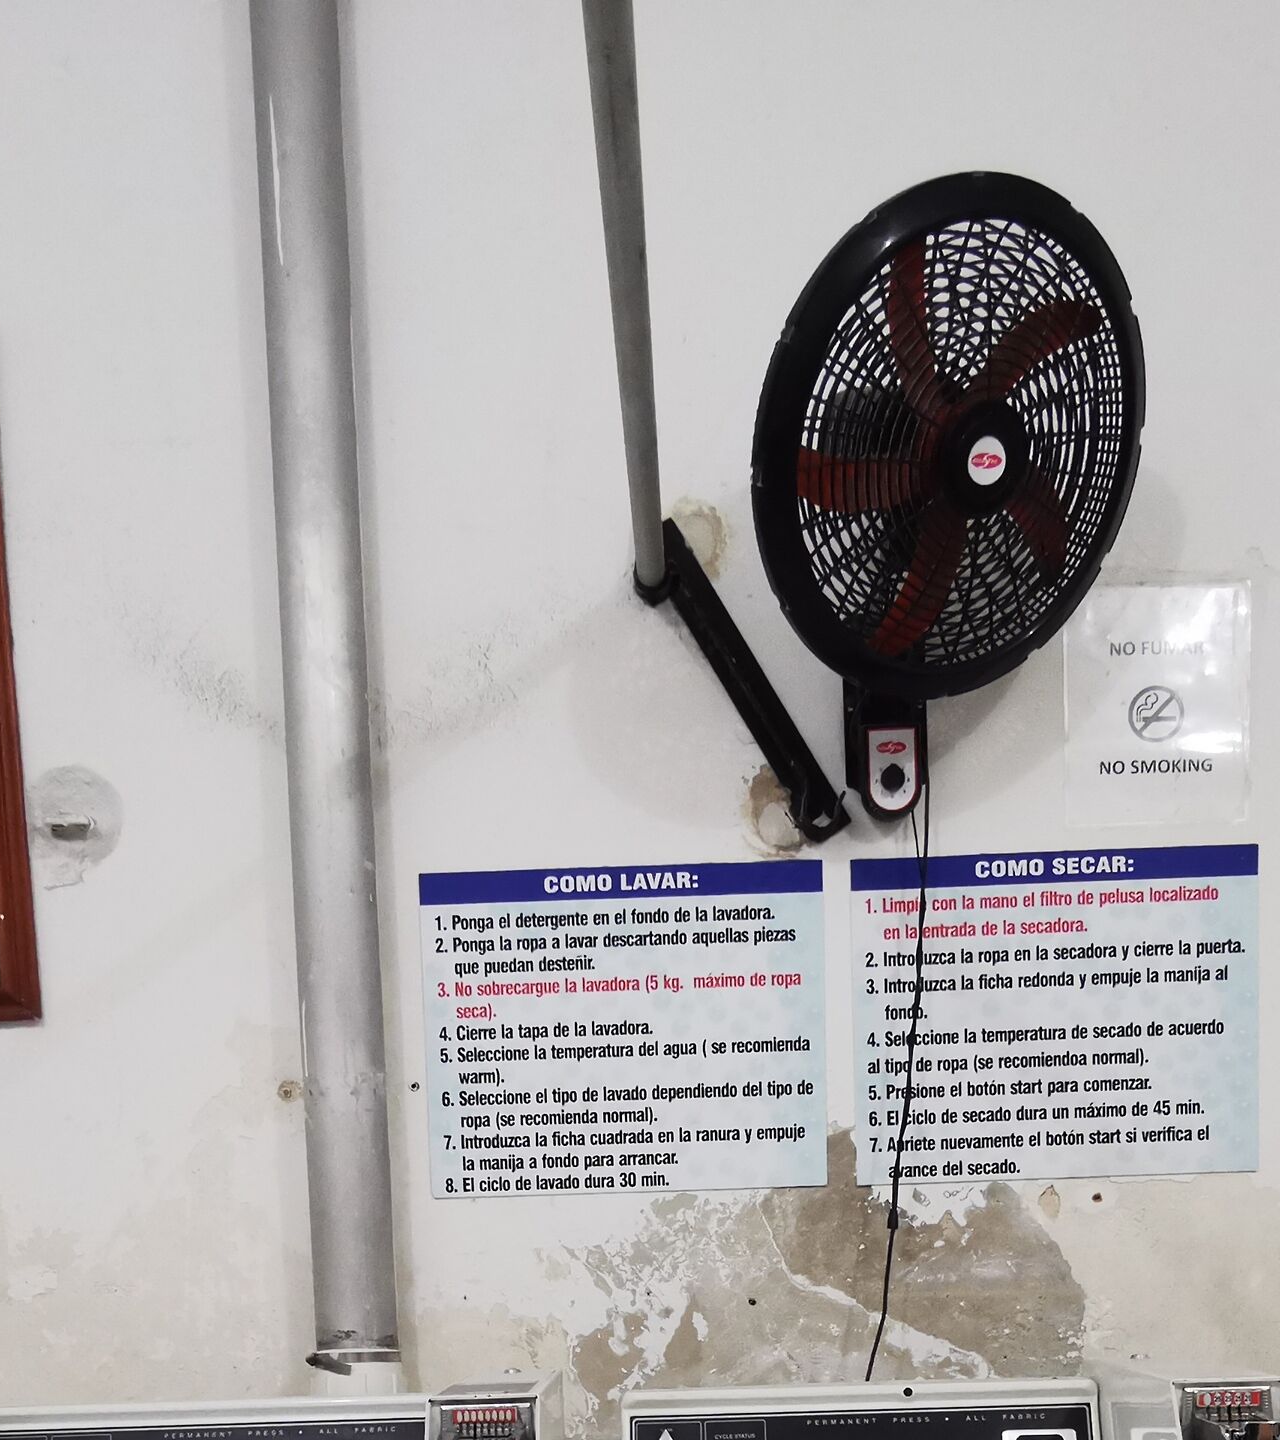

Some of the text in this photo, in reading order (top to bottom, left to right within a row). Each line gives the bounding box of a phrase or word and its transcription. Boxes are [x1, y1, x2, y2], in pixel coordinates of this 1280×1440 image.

[1110, 642, 1136, 656] NO
[1099, 758, 1213, 775] NO SMOKING
[975, 856, 1134, 878] COMO SECAR:
[544, 872, 698, 893] COMO LAVAR:
[865, 885, 1219, 915] 1. Limpi con la mano el filtro de pelusa localizado
[434, 904, 775, 933] 1. Ponga el detergente en el fondo de la lavadora.
[883, 917, 1088, 940] en la entrada de la secadora.
[437, 972, 801, 998] 3. No sobrecargue la lavadora (5 kg. máximo de ropa
[456, 1002, 497, 1022] seca).
[868, 1084, 882, 1101] 5.
[950, 1081, 962, 1098] el
[967, 1080, 1006, 1097] botón
[1010, 1078, 1043, 1095] start
[1047, 1080, 1079, 1098] para
[1083, 1078, 1152, 1092] comenzar.
[807, 1417, 877, 1425] PERMANENT
[893, 1416, 931, 1424] PRESS
[1002, 1413, 1046, 1421] FABRIC
[164, 1431, 232, 1439] PERMANENT
[354, 1426, 397, 1434] FABRIC
